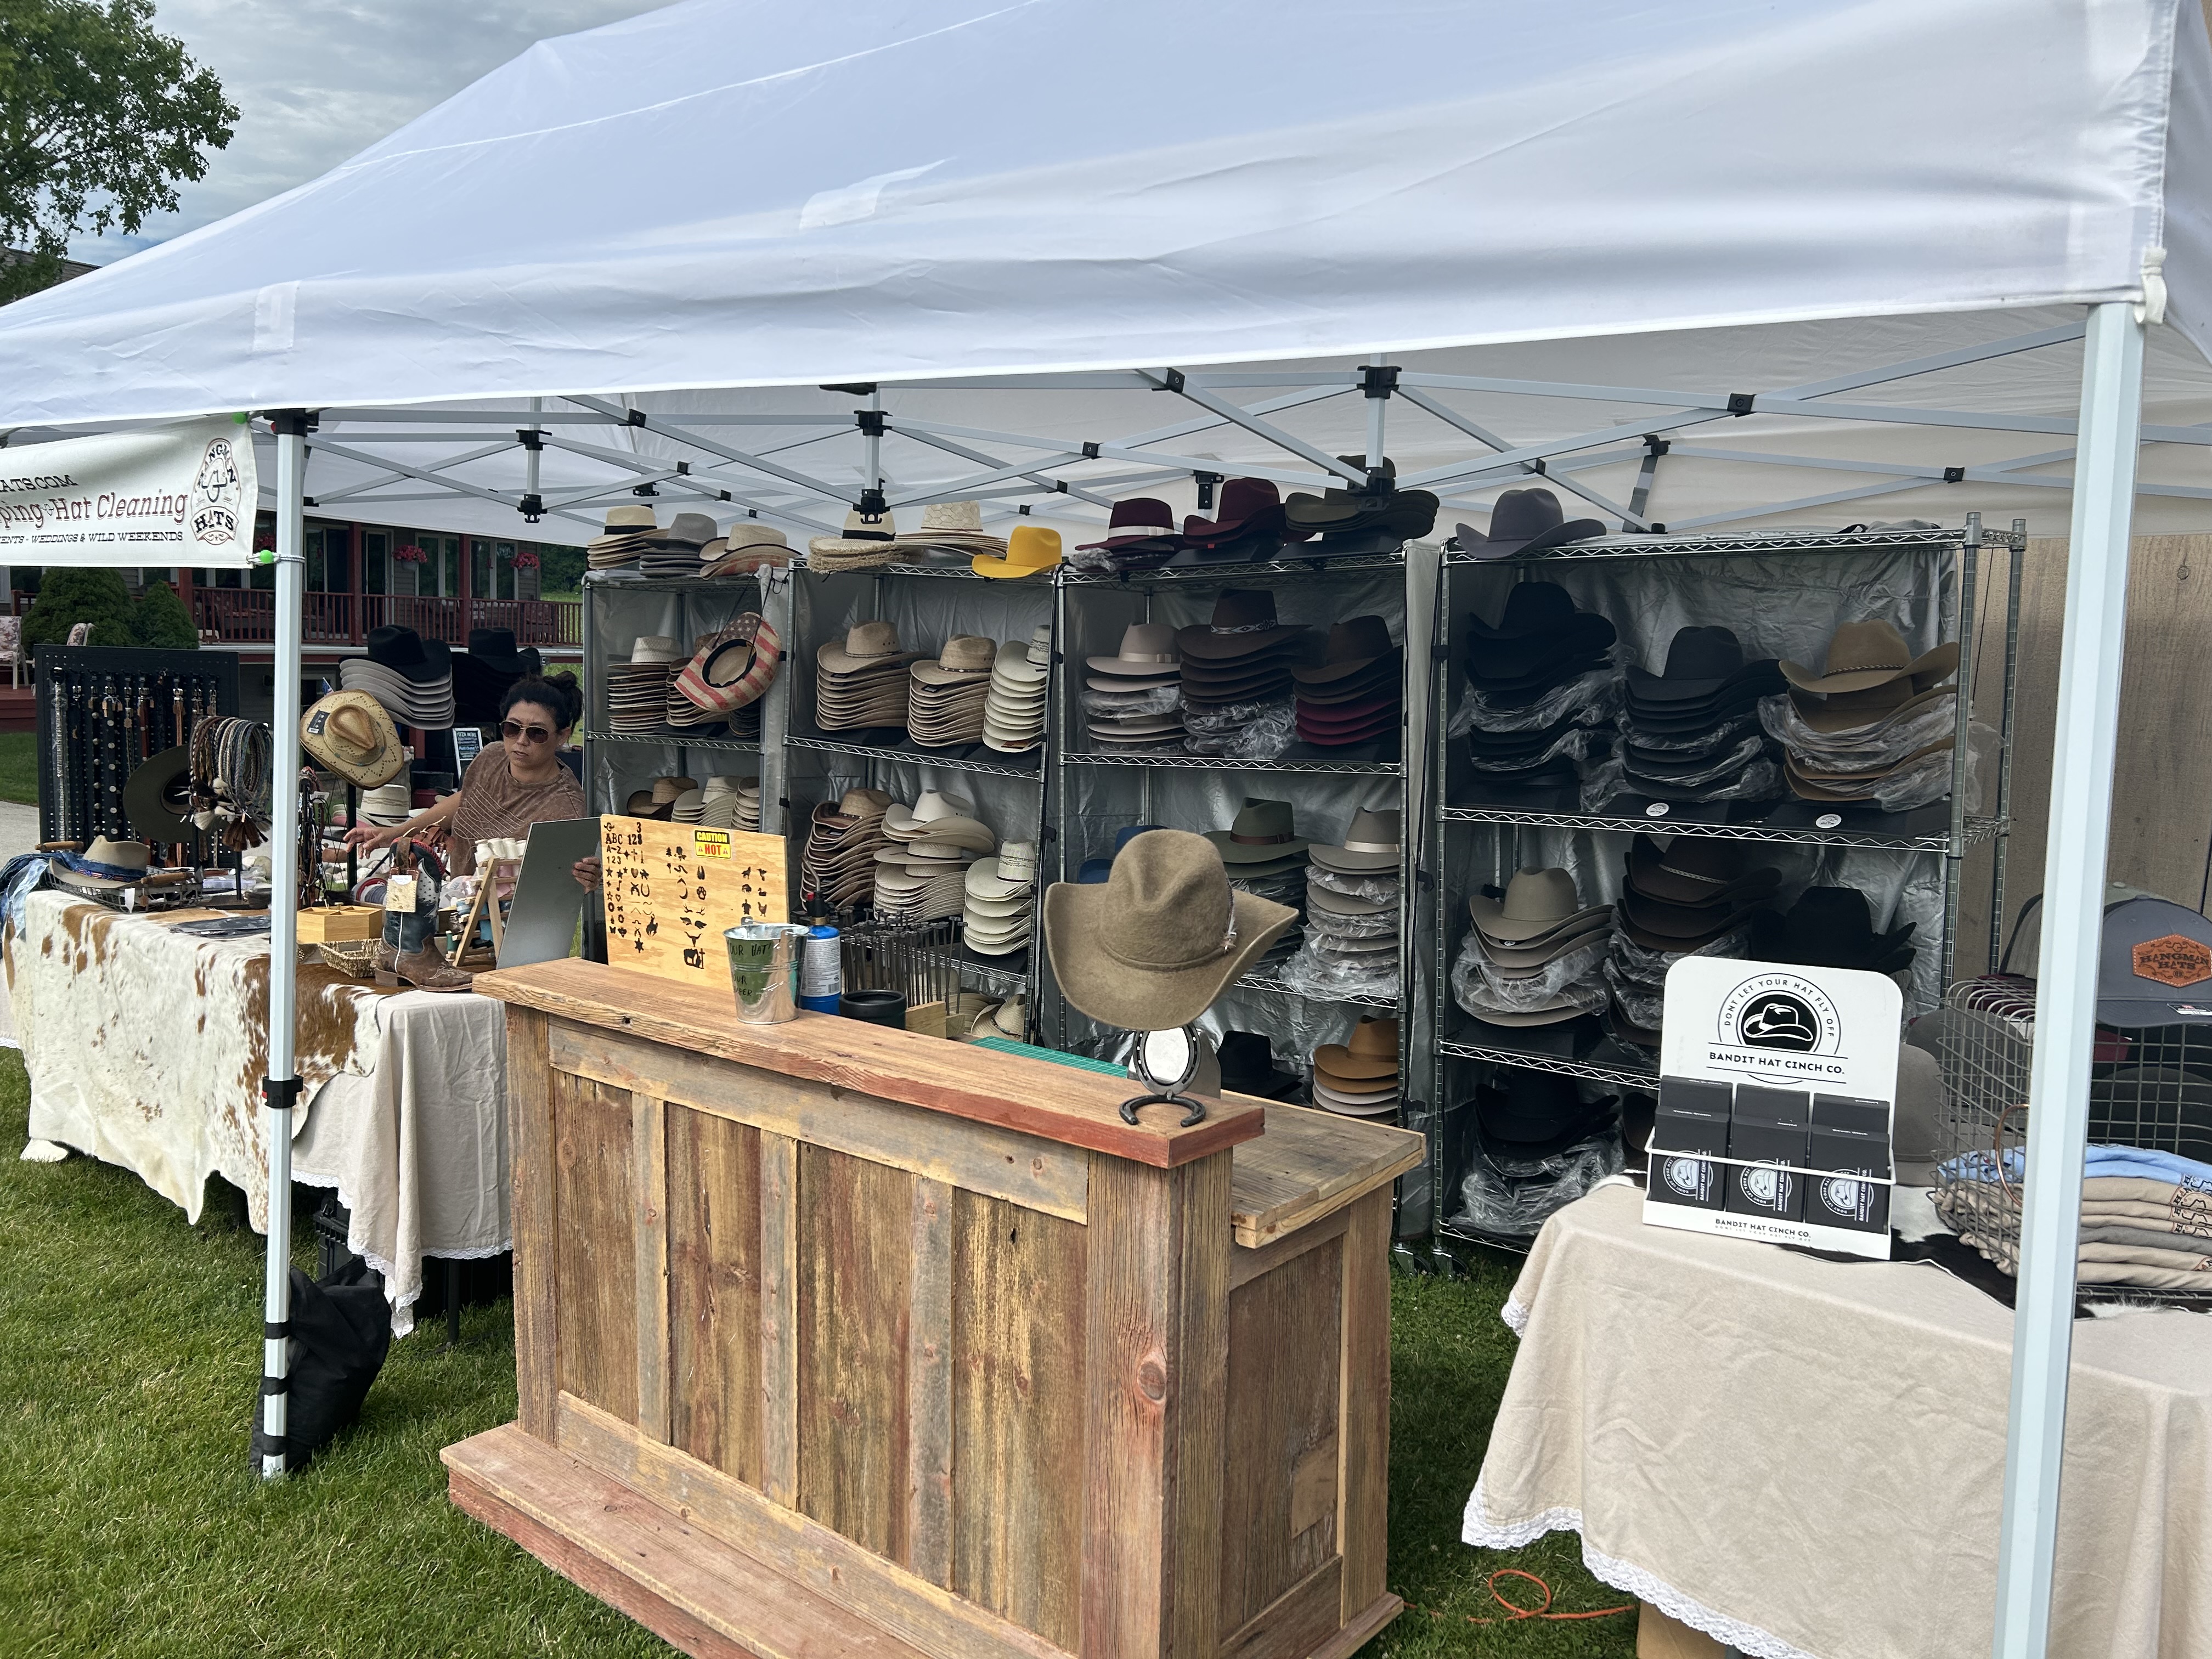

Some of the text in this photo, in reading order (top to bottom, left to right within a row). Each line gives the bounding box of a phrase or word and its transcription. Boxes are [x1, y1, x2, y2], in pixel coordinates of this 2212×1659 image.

[48, 496, 91, 521] Hat
[97, 488, 188, 525] Cleaning
[194, 510, 234, 534] HATS
[31, 533, 78, 544] WEDDINGS
[80, 533, 85, 543] &
[88, 532, 115, 541] WILD
[117, 531, 183, 541] WEEKENDS
[605, 833, 623, 845] ABC
[697, 831, 727, 843] CAUTION
[704, 844, 721, 855] HOT
[2139, 952, 2209, 966] HANGMAN
[2158, 961, 2196, 970] HATS
[1724, 979, 1835, 1037] DONT LET YOUR HAT FLY OFF
[1709, 1052, 1845, 1075] BANDIT HAT CINCH CO.
[1716, 1218, 1748, 1228] BANDIT
[1769, 1227, 1796, 1235] CINCH
